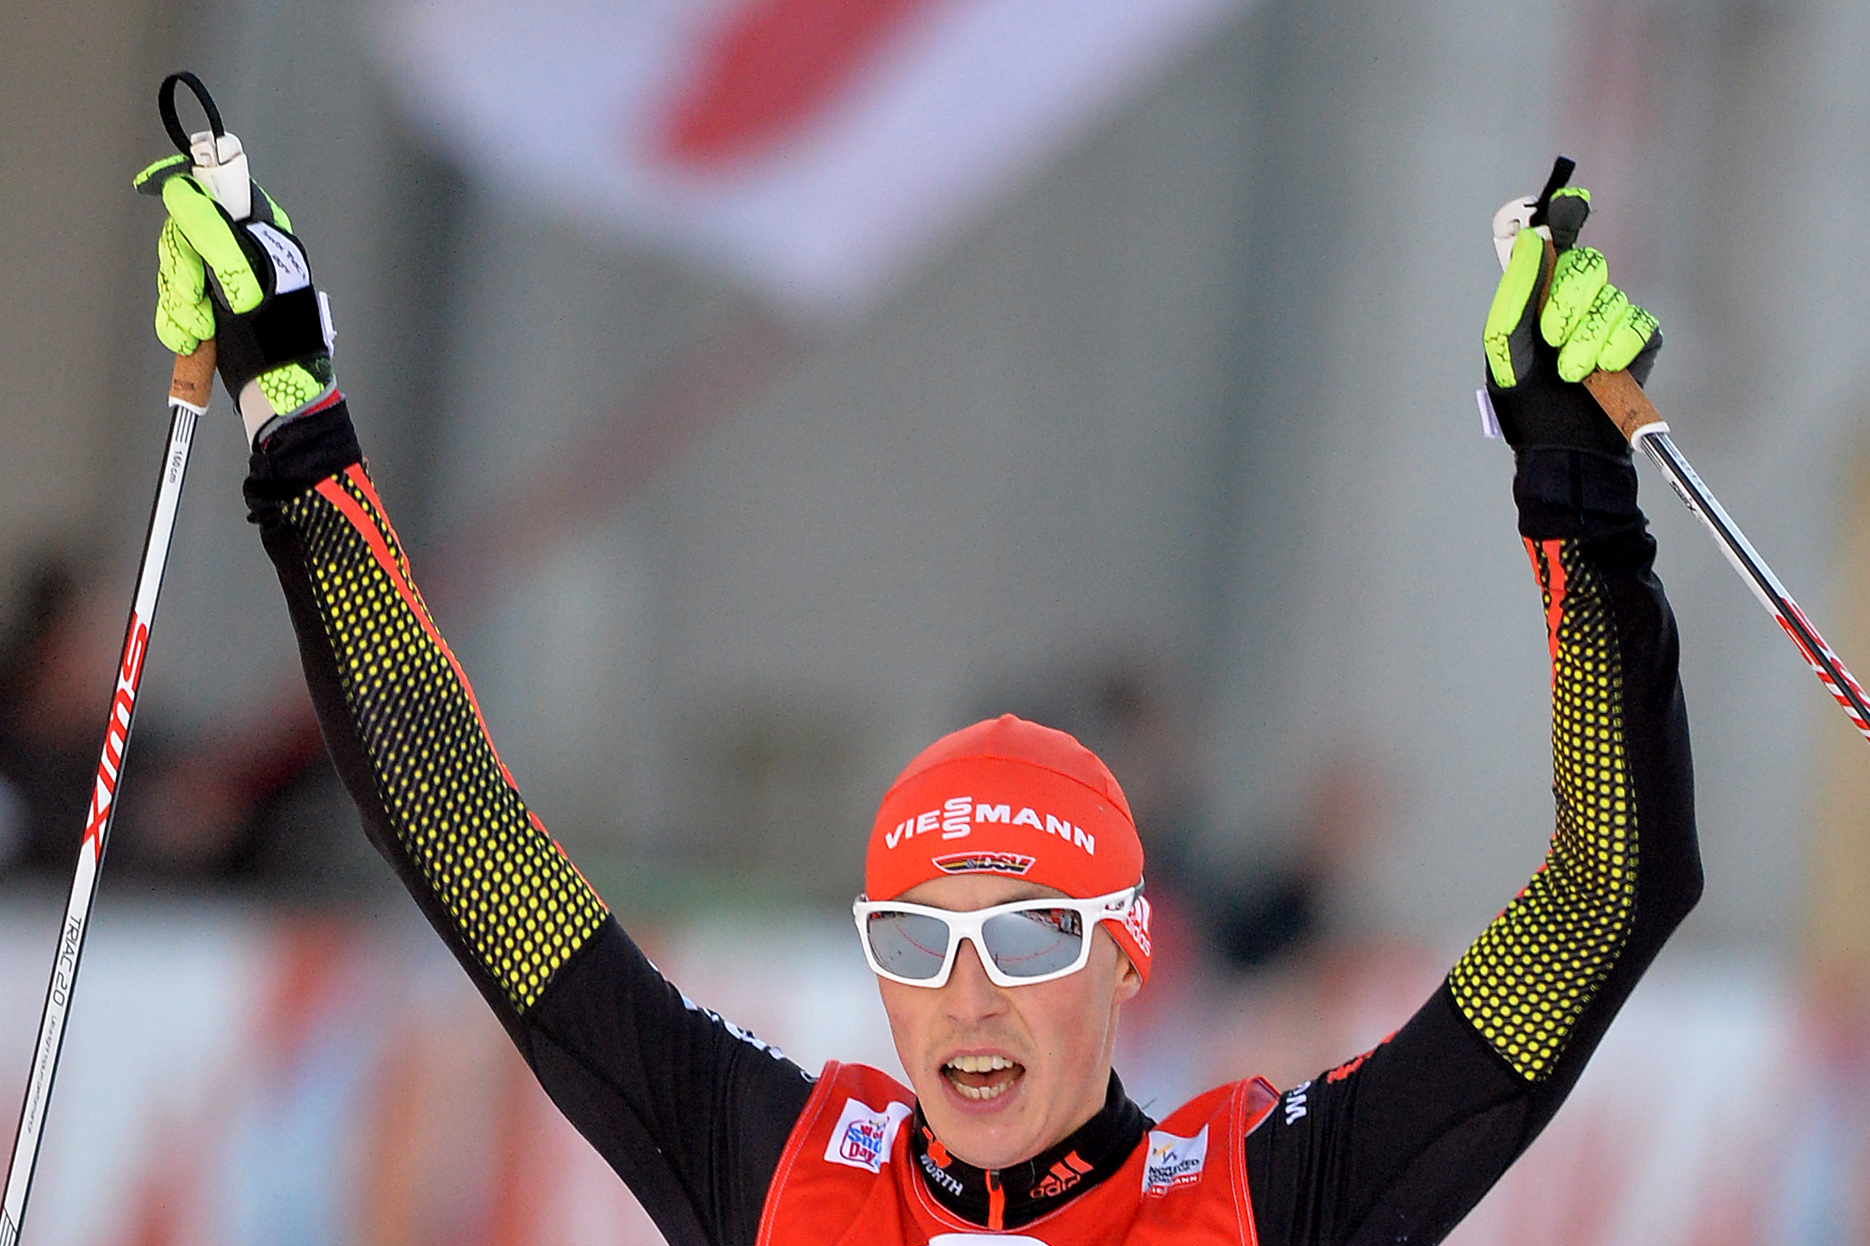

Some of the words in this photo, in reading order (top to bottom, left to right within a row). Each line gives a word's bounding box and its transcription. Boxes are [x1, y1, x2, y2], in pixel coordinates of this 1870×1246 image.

[885, 796, 1095, 855] VIESSMANN
[59, 915, 82, 972] TRIAC
[849, 1141, 876, 1162] Day
